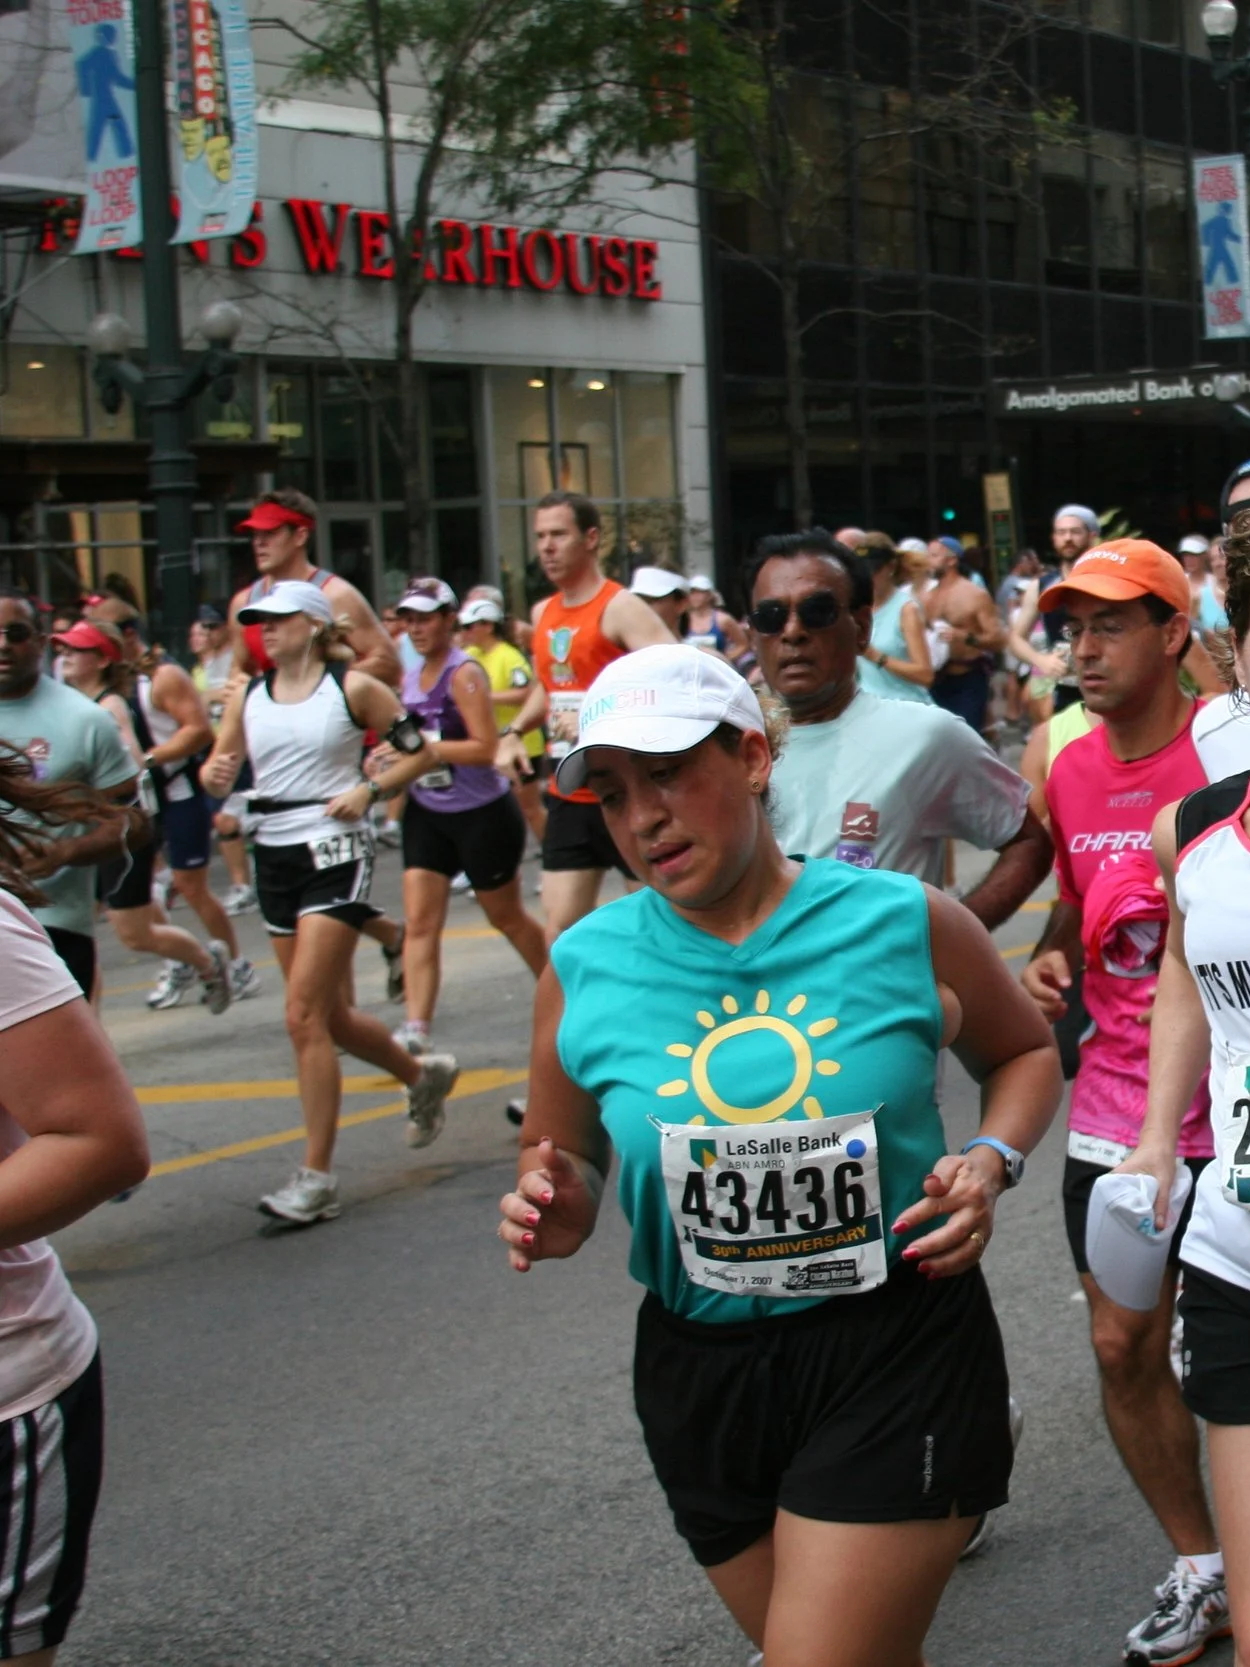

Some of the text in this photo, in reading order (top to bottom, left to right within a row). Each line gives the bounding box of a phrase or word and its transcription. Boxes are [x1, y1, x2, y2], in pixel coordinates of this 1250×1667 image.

[91, 167, 137, 190] LOOP
[89, 203, 137, 226] LOOP
[287, 197, 662, 301] WERHOUSE
[1006, 381, 1140, 410] Amalgamated
[1145, 376, 1195, 400] Bank
[1194, 962, 1236, 1012] IT'S
[726, 1131, 842, 1156] LaSalle Bank
[727, 1159, 786, 1170] ABN AMRO
[681, 1161, 867, 1235] 43436
[711, 1225, 868, 1259] 30th ANNIVERSARY
[741, 1276, 749, 1285] 7,
[751, 1276, 773, 1286] 2007
